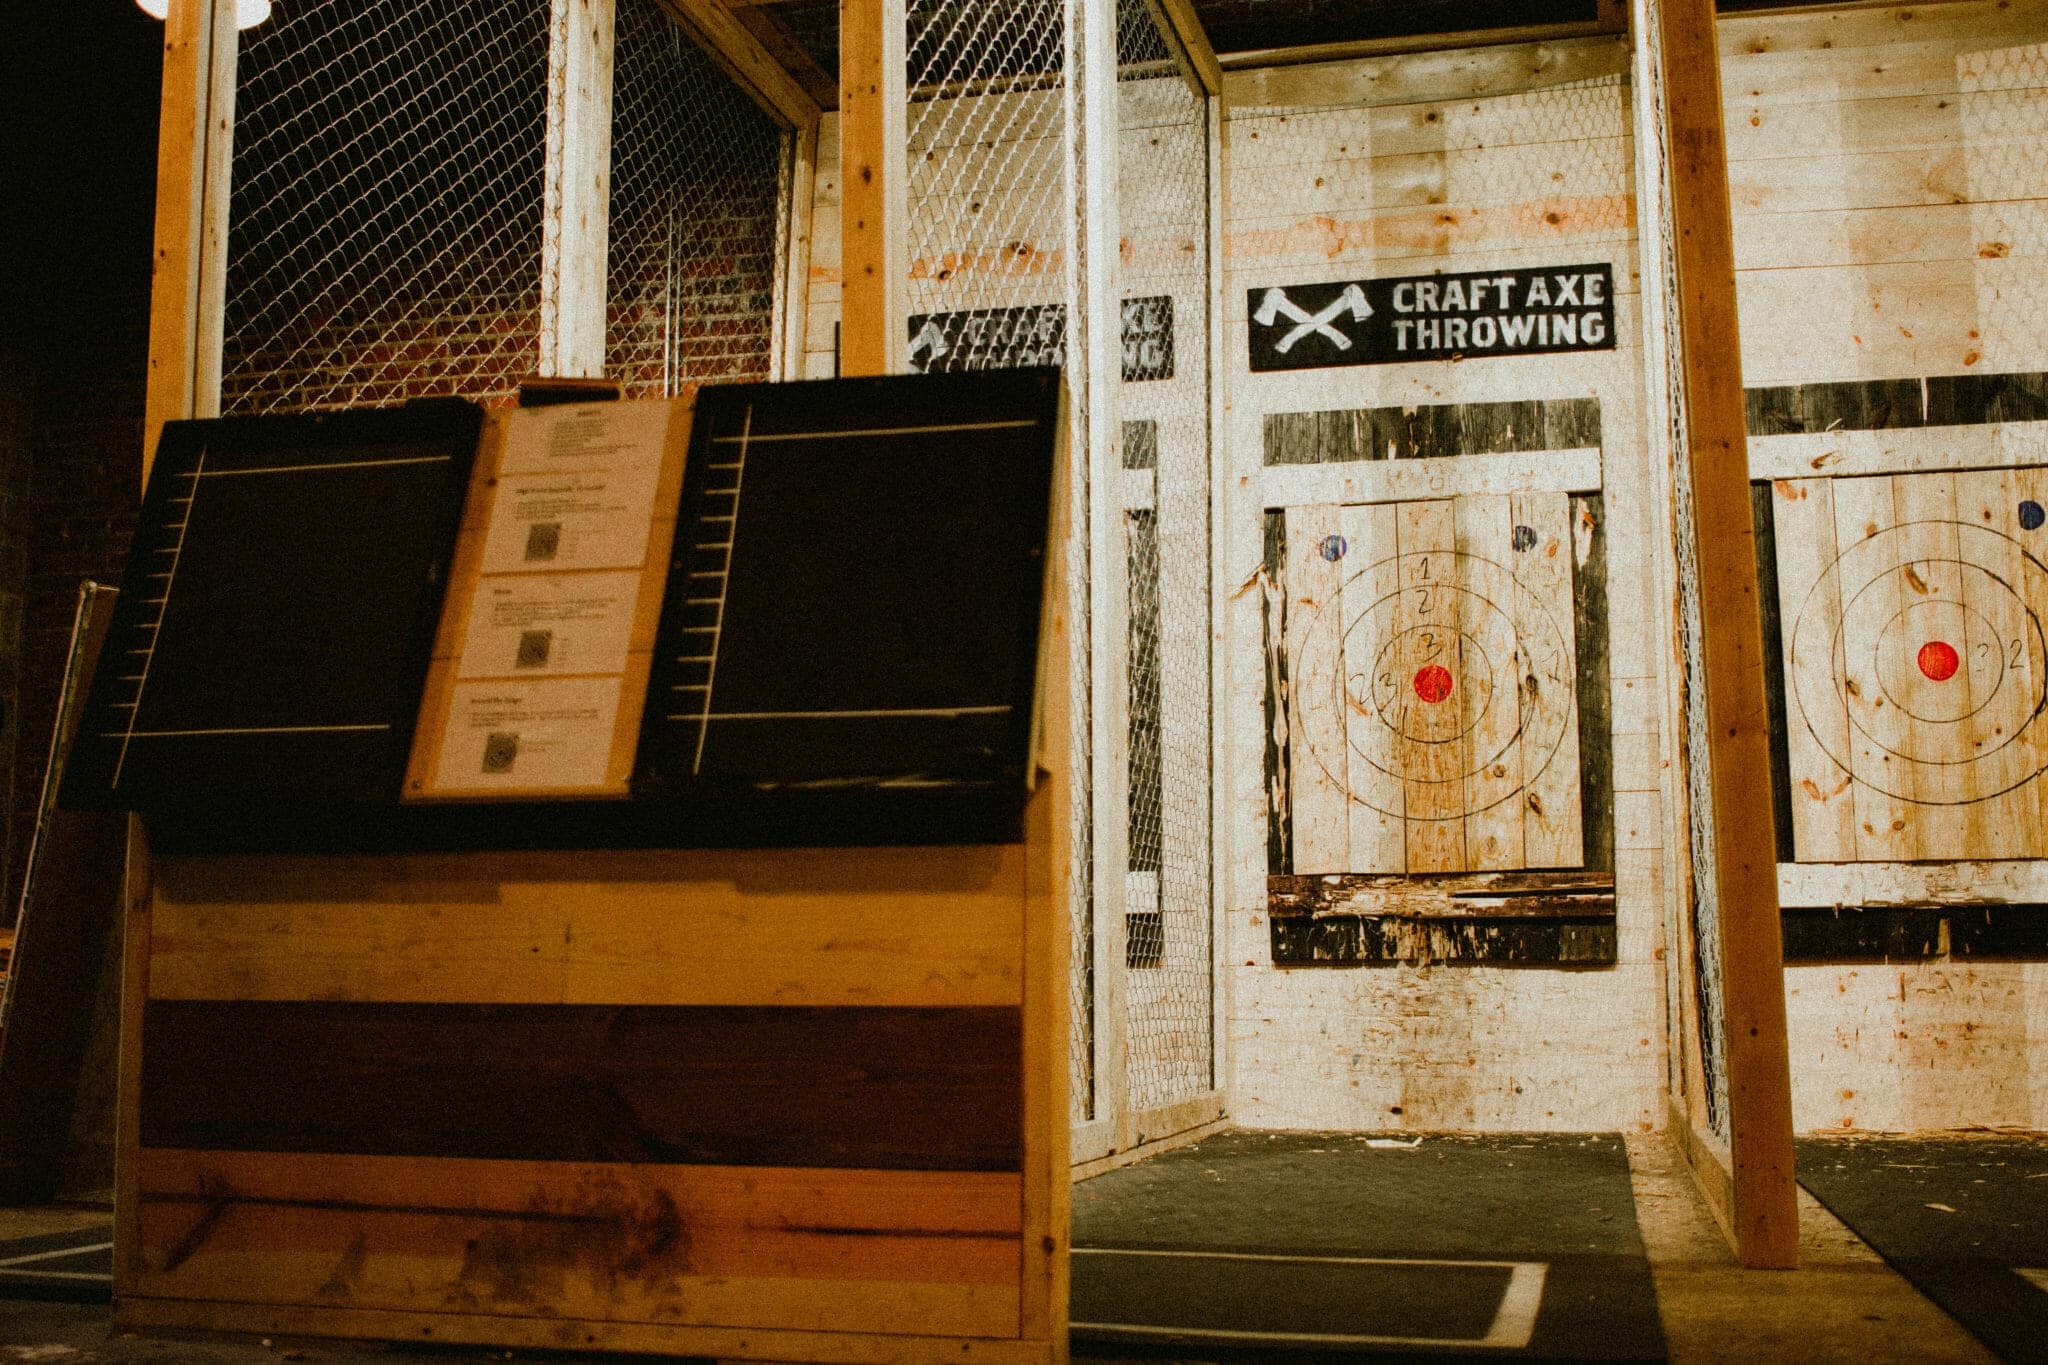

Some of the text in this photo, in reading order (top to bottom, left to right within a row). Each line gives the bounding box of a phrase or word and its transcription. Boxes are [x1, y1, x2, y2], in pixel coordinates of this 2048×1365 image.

[1392, 272, 1606, 313] CRAFT AXE
[1390, 311, 1606, 351] THROWING
[1420, 556, 1431, 580] 1
[1415, 589, 1435, 614] 2
[2009, 638, 2025, 669] 2
